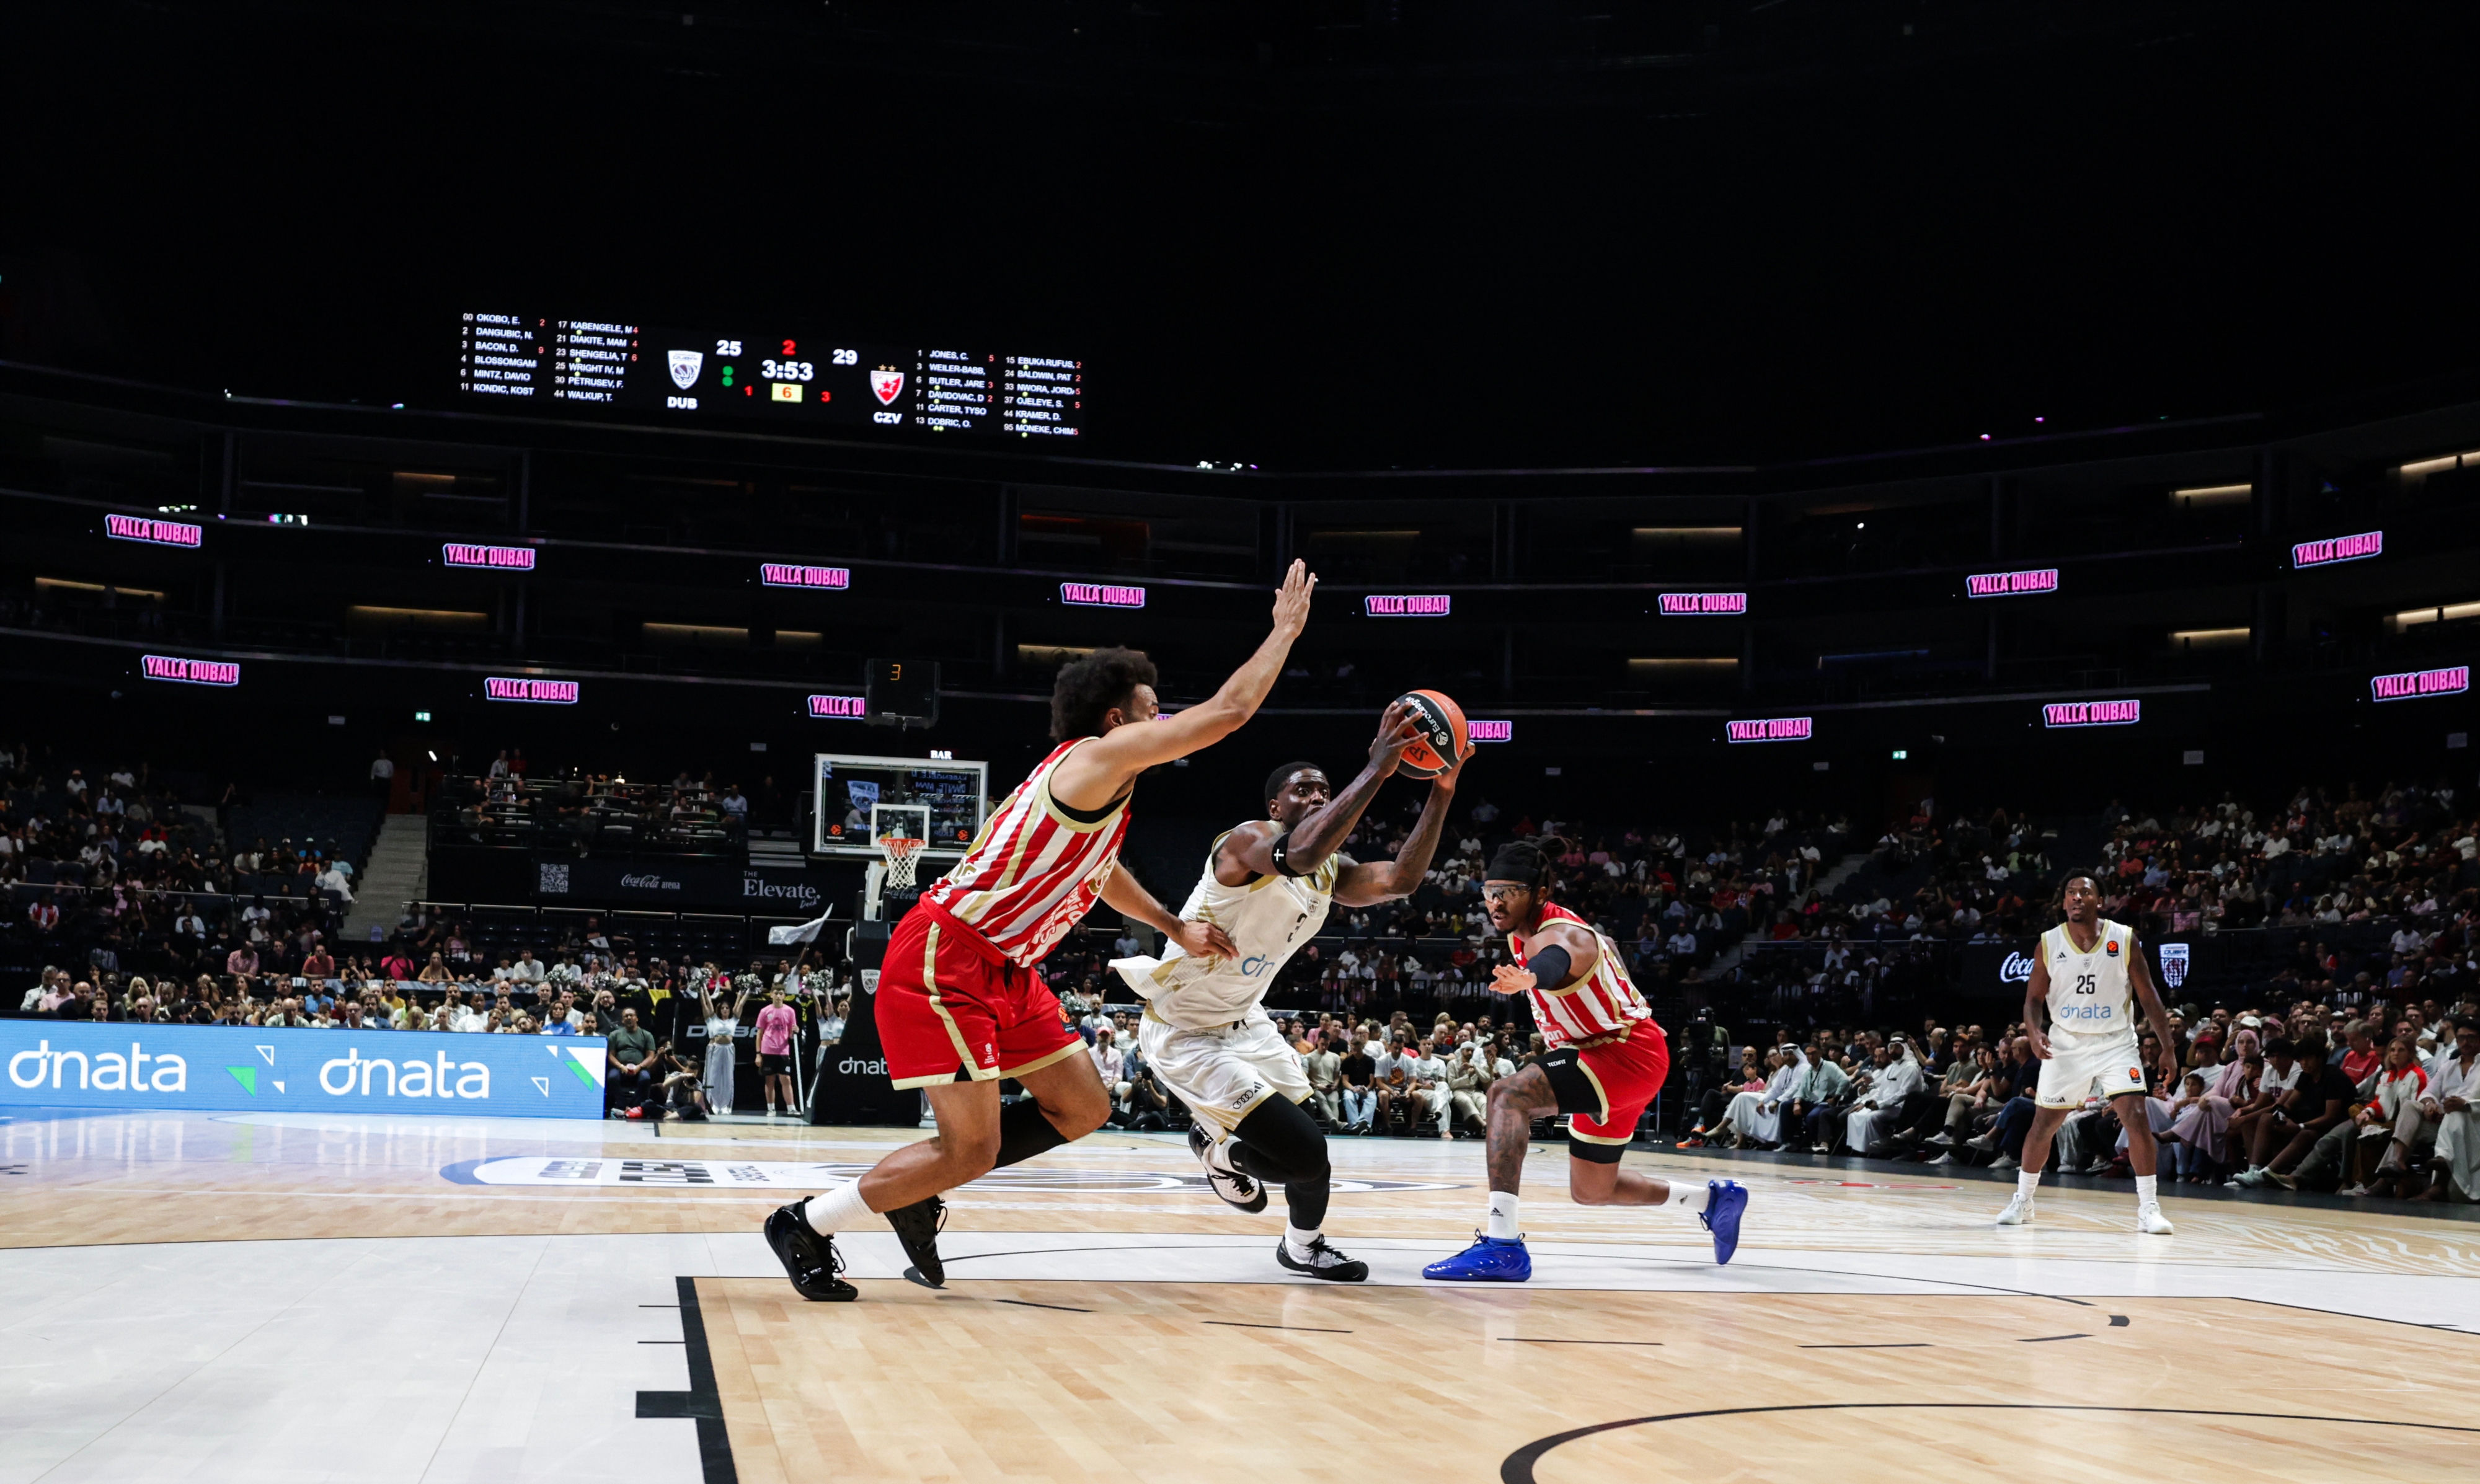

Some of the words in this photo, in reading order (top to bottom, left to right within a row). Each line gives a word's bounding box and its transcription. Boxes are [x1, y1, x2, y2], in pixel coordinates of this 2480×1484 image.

[463, 313, 473, 321] 00
[476, 314, 510, 325] OKOBO,
[512, 316, 520, 325] E.
[463, 327, 467, 335] 2
[476, 327, 523, 340] DANGUBIC,
[525, 331, 533, 340] N.
[570, 321, 623, 334] KABENGELE,
[557, 334, 565, 342] 21
[570, 335, 605, 346] DIAKITE,
[606, 338, 627, 347] MAM
[782, 339, 796, 355] 2
[476, 342, 508, 353] BACON,
[510, 344, 519, 353] D.
[716, 340, 742, 356] 25
[556, 348, 566, 356] 23
[570, 349, 619, 361] SHENGELIA,
[832, 348, 858, 365] 29
[929, 350, 959, 360] JONES,
[556, 362, 565, 370] 25
[569, 363, 603, 373] WRIGHT
[604, 366, 614, 374] IV,
[761, 360, 813, 381] 3:53
[929, 363, 985, 376] WEILER-BABB,
[1045, 359, 1075, 369] RUFUS,
[474, 369, 502, 380] MINTZ,
[1017, 370, 1056, 381] BALDWIN,
[1056, 373, 1072, 381] PAT
[474, 383, 509, 395] KONDIC,
[510, 386, 534, 395] KOST
[568, 376, 615, 389] PETRUSEV,
[616, 380, 623, 388] F.
[929, 377, 962, 387] BUTLER,
[964, 380, 985, 389] JARE
[1017, 384, 1050, 394] NWORA,
[567, 391, 604, 402] WALKUP,
[606, 393, 613, 402] T.
[745, 386, 752, 397] 1
[782, 386, 792, 398] 6
[822, 391, 831, 402] 3
[928, 391, 976, 402] DAVIDOVAC,
[667, 396, 698, 410] DUB
[928, 404, 963, 414] CARTER,
[1016, 397, 1055, 408] OJELEYE,
[1055, 400, 1063, 408] S.
[873, 412, 902, 424] CZV
[1015, 410, 1053, 420] KRAMER,
[1053, 413, 1061, 421] D.
[928, 417, 961, 428] DOBRIC,
[1016, 424, 1052, 434] MONEKE,
[110, 516, 150, 538] YALLA
[153, 522, 199, 544] DUBAI!
[2297, 541, 2334, 563] YALLA
[2336, 533, 2381, 558] DUBAI!
[448, 545, 486, 563] YALLA
[489, 547, 533, 567] DUBAI!
[765, 565, 802, 583] YALLA
[805, 567, 847, 586] DUBAI!
[1971, 575, 2009, 594] YALLA
[2011, 571, 2056, 591] DUBAI!
[1065, 585, 1100, 602] YALLA
[1102, 587, 1143, 605] DUBAI!
[1369, 597, 1405, 613] YALLA
[1407, 597, 1448, 613] DUBAI!
[1663, 595, 1699, 611] YALLA
[1702, 594, 1745, 611] DUBAI!
[147, 657, 187, 678] YALLA
[190, 662, 237, 682] DUBAI!
[890, 665, 901, 680] 3
[2376, 674, 2416, 697] YALLA
[2419, 668, 2467, 692] DUBAI!
[489, 679, 528, 698] YALLA
[531, 681, 577, 700] DUBAI!
[812, 697, 849, 715] YALLA
[2048, 704, 2088, 723] YALLA
[2091, 701, 2138, 722] DUBAI!
[1730, 721, 1766, 739] YALLA
[1769, 719, 1810, 738] DUBAI!
[930, 750, 952, 760] BAR
[661, 881, 681, 890] arena
[2076, 974, 2095, 994] 25
[2060, 1003, 2111, 1019] dnata
[9, 1040, 186, 1091] dnata
[839, 1057, 891, 1075] dnat
[320, 1048, 489, 1098] dnata
